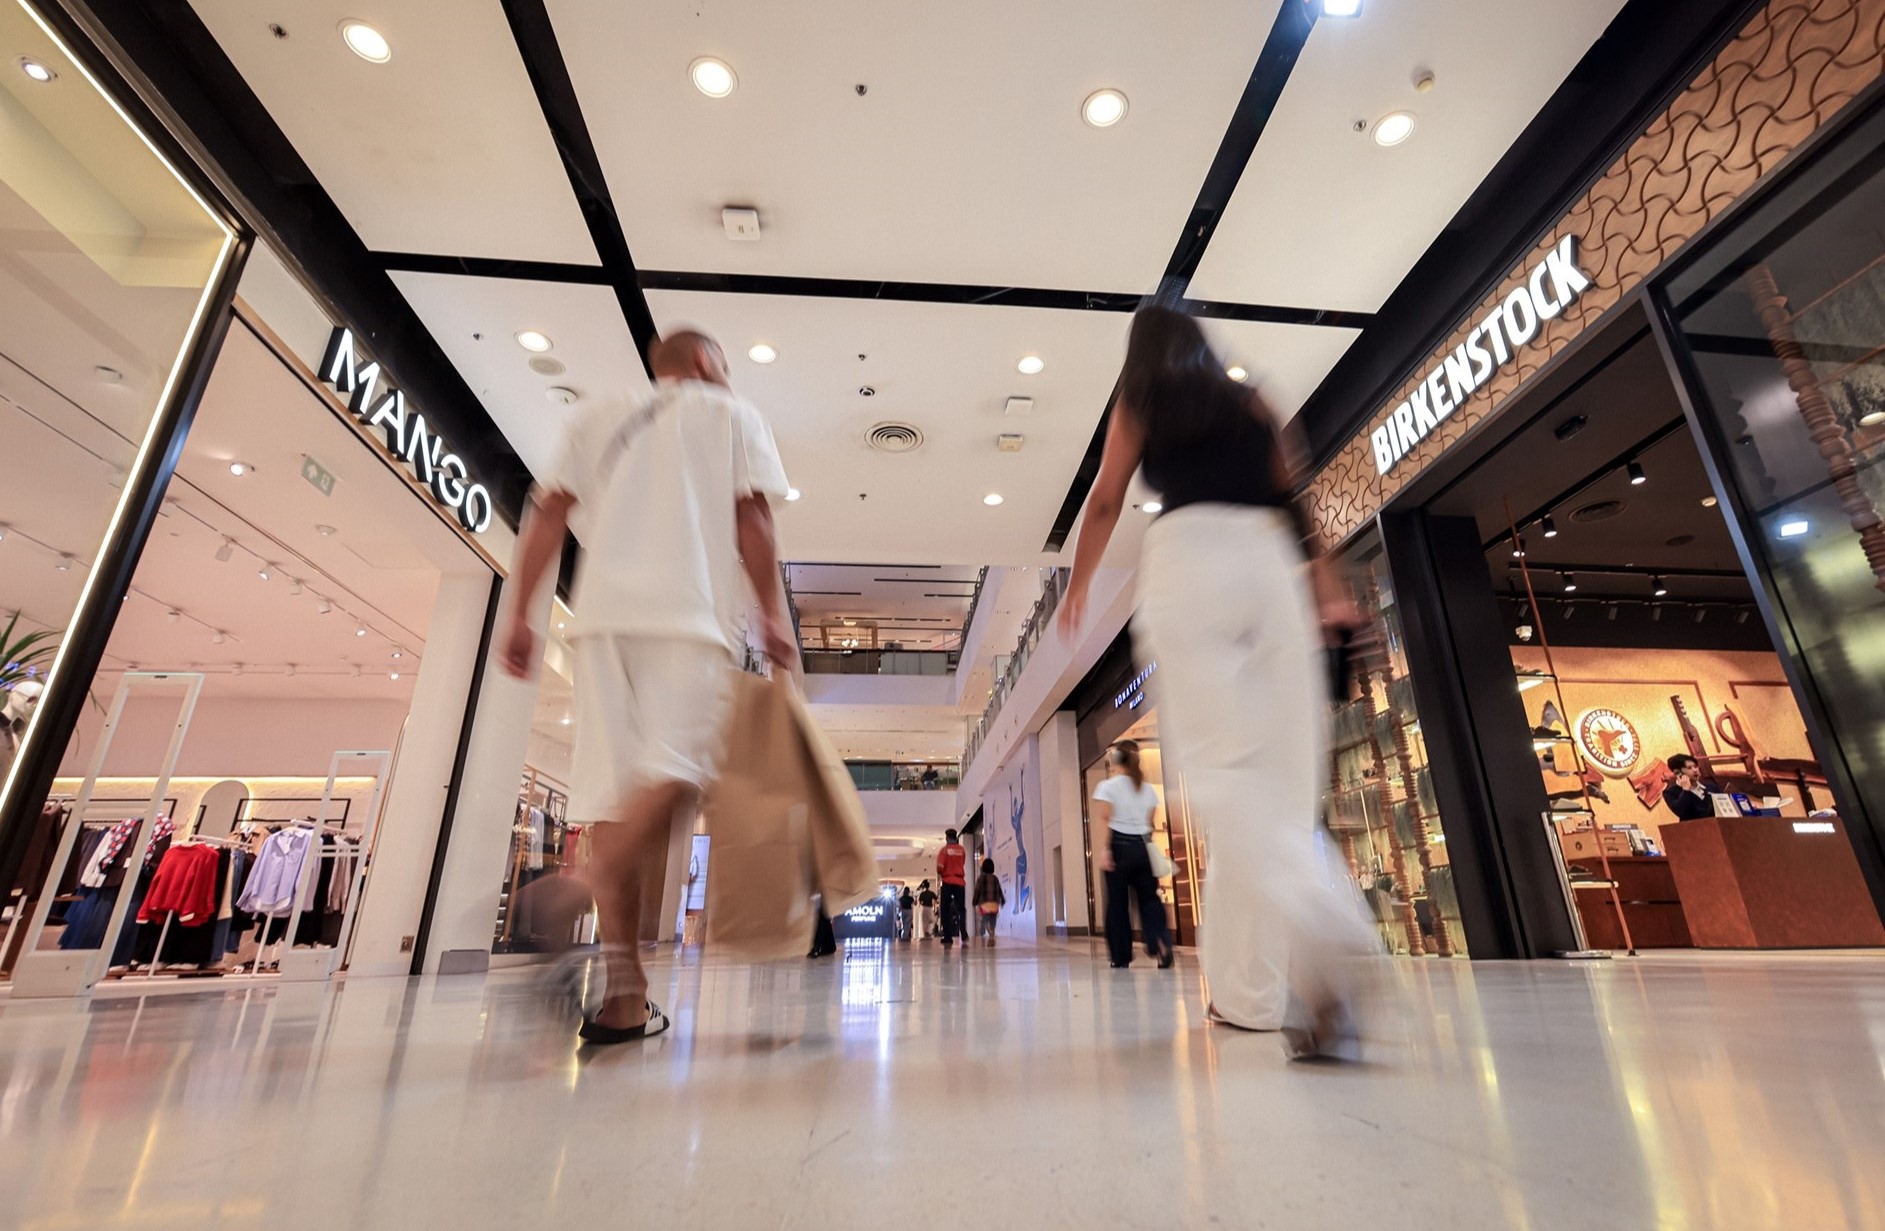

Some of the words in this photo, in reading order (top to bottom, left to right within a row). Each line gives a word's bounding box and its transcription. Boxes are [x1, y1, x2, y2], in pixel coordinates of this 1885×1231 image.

[1371, 233, 1589, 476] BIRKENSTOCK
[328, 327, 492, 533] MANGO
[1114, 660, 1157, 709] BONAVENTURA
[844, 905, 884, 916] AMOLN
